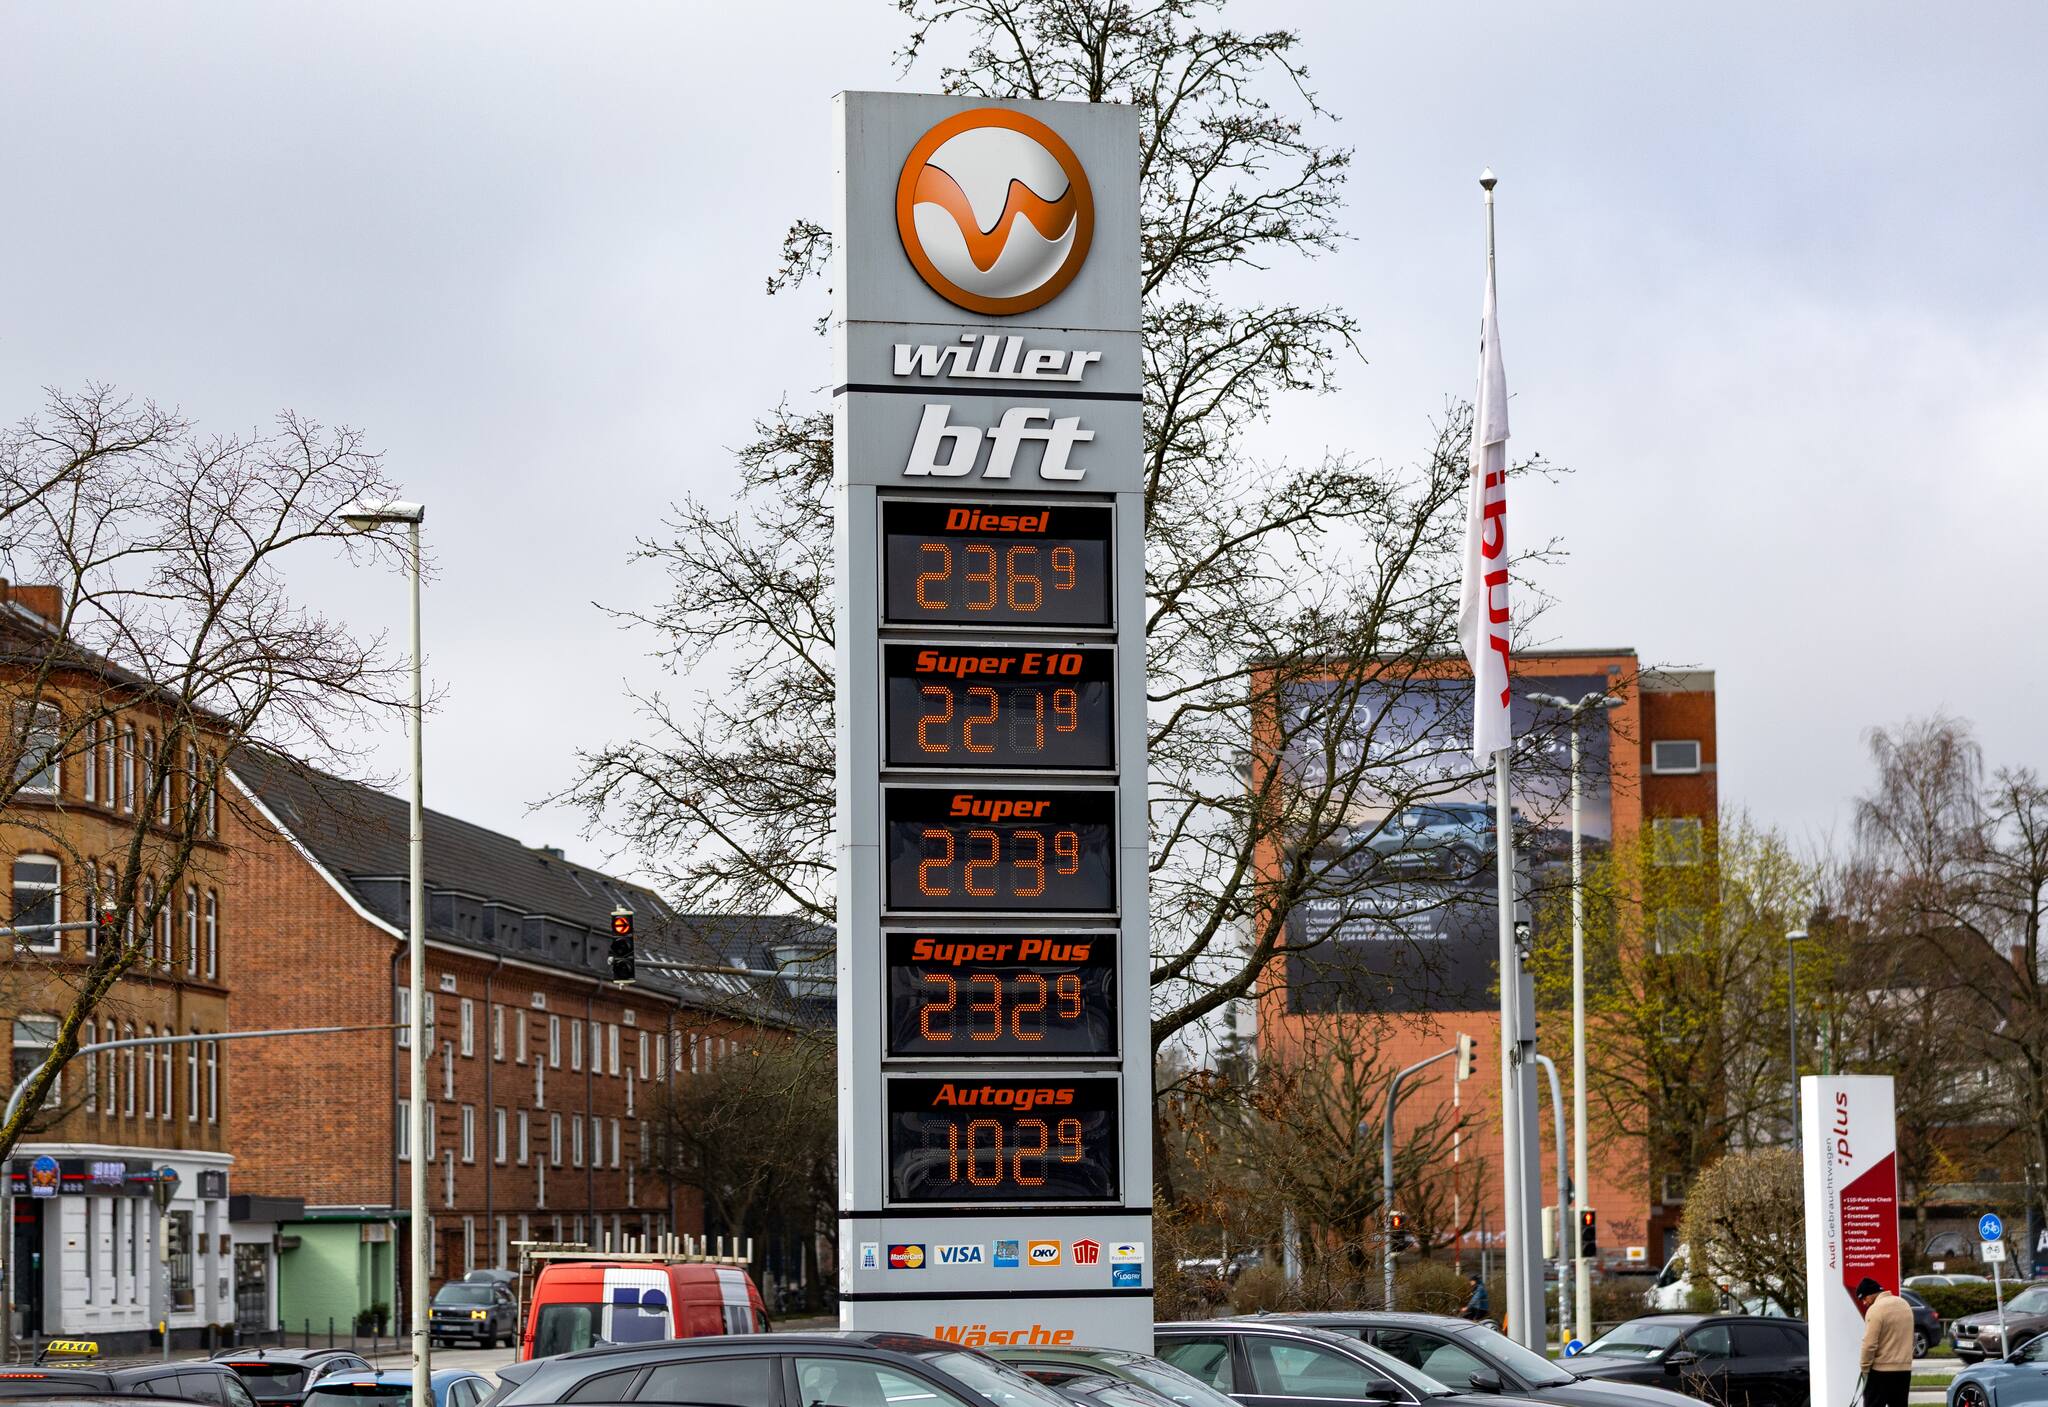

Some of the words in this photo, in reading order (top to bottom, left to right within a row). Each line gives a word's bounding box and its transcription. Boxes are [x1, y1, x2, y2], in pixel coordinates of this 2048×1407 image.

[893, 333, 1102, 382] willer
[903, 404, 1095, 480] bft
[945, 508, 1050, 532] Diesel
[916, 651, 1016, 678] Super
[950, 794, 1050, 822] Super
[912, 938, 1012, 966] Super
[1017, 939, 1092, 961] Plus
[932, 1084, 1075, 1111] Autogas
[1826, 1138, 1836, 1238] Gebrauchtwagen
[891, 1253, 923, 1261] MasterCard
[938, 1247, 982, 1263] VISA
[1032, 1249, 1056, 1258] DKV
[1072, 1238, 1100, 1264] UTA
[52, 1342, 90, 1352] TAXI
[935, 1324, 1074, 1347] Wäsche
